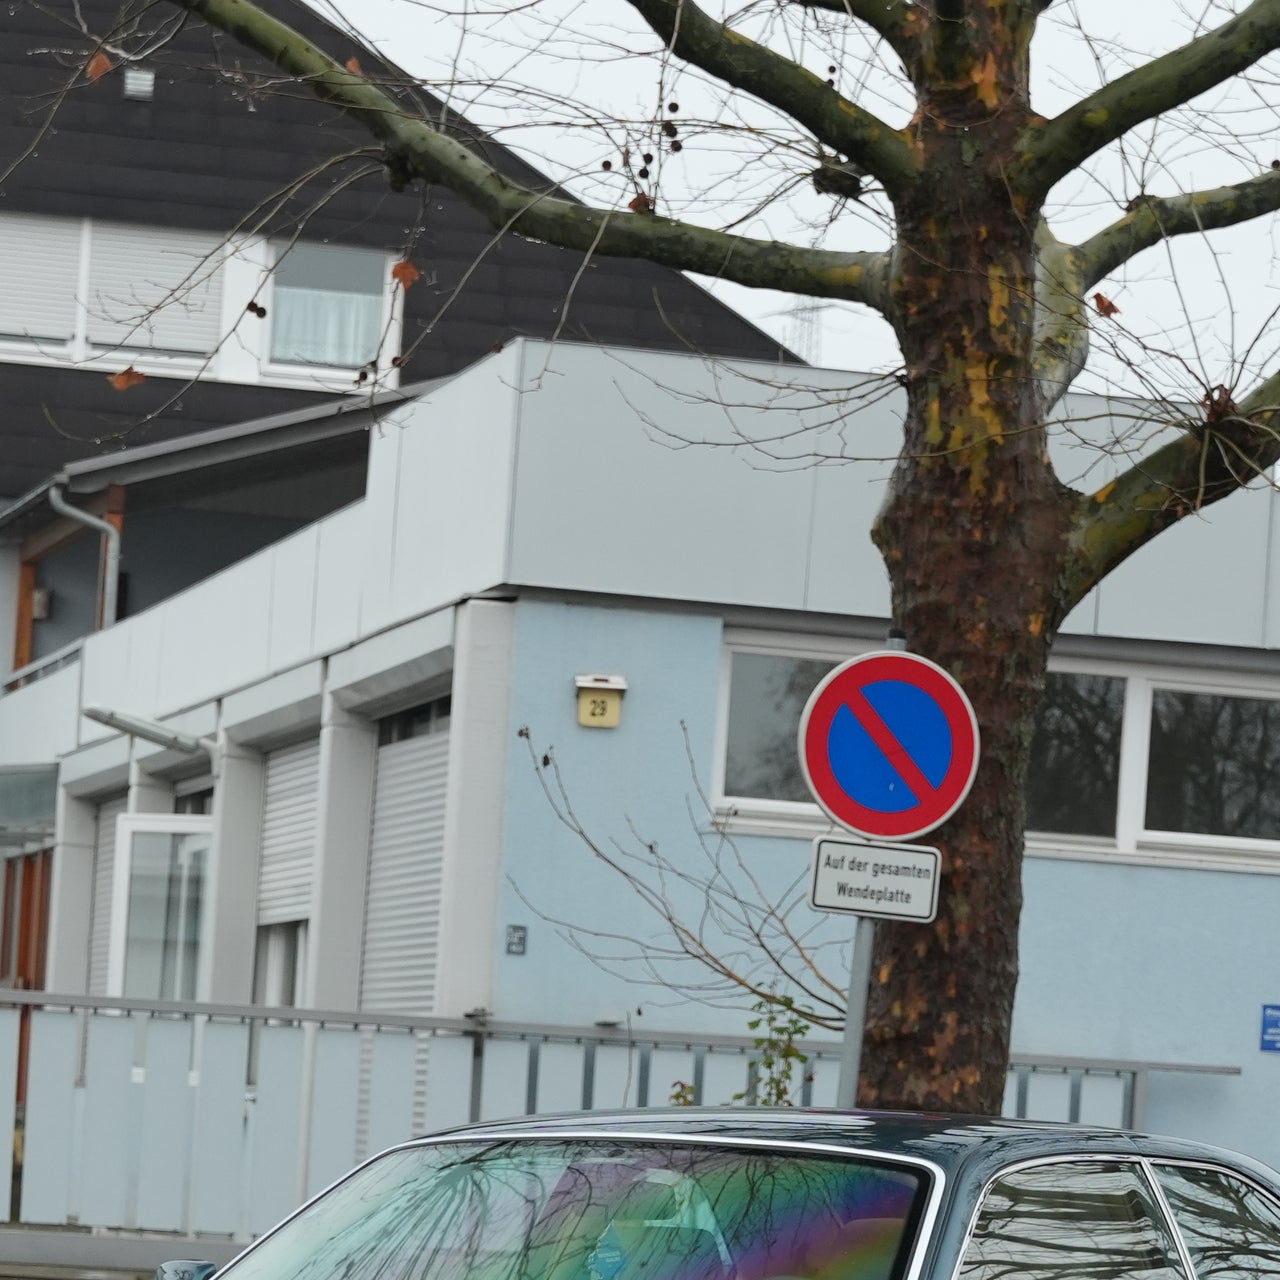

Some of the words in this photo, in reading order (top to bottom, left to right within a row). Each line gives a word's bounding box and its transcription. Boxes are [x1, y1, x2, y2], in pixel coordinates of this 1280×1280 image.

[823, 853, 845, 870] Auf
[848, 855, 868, 873] der
[871, 860, 931, 881] gesamten
[836, 881, 913, 905] Wendeplatte
